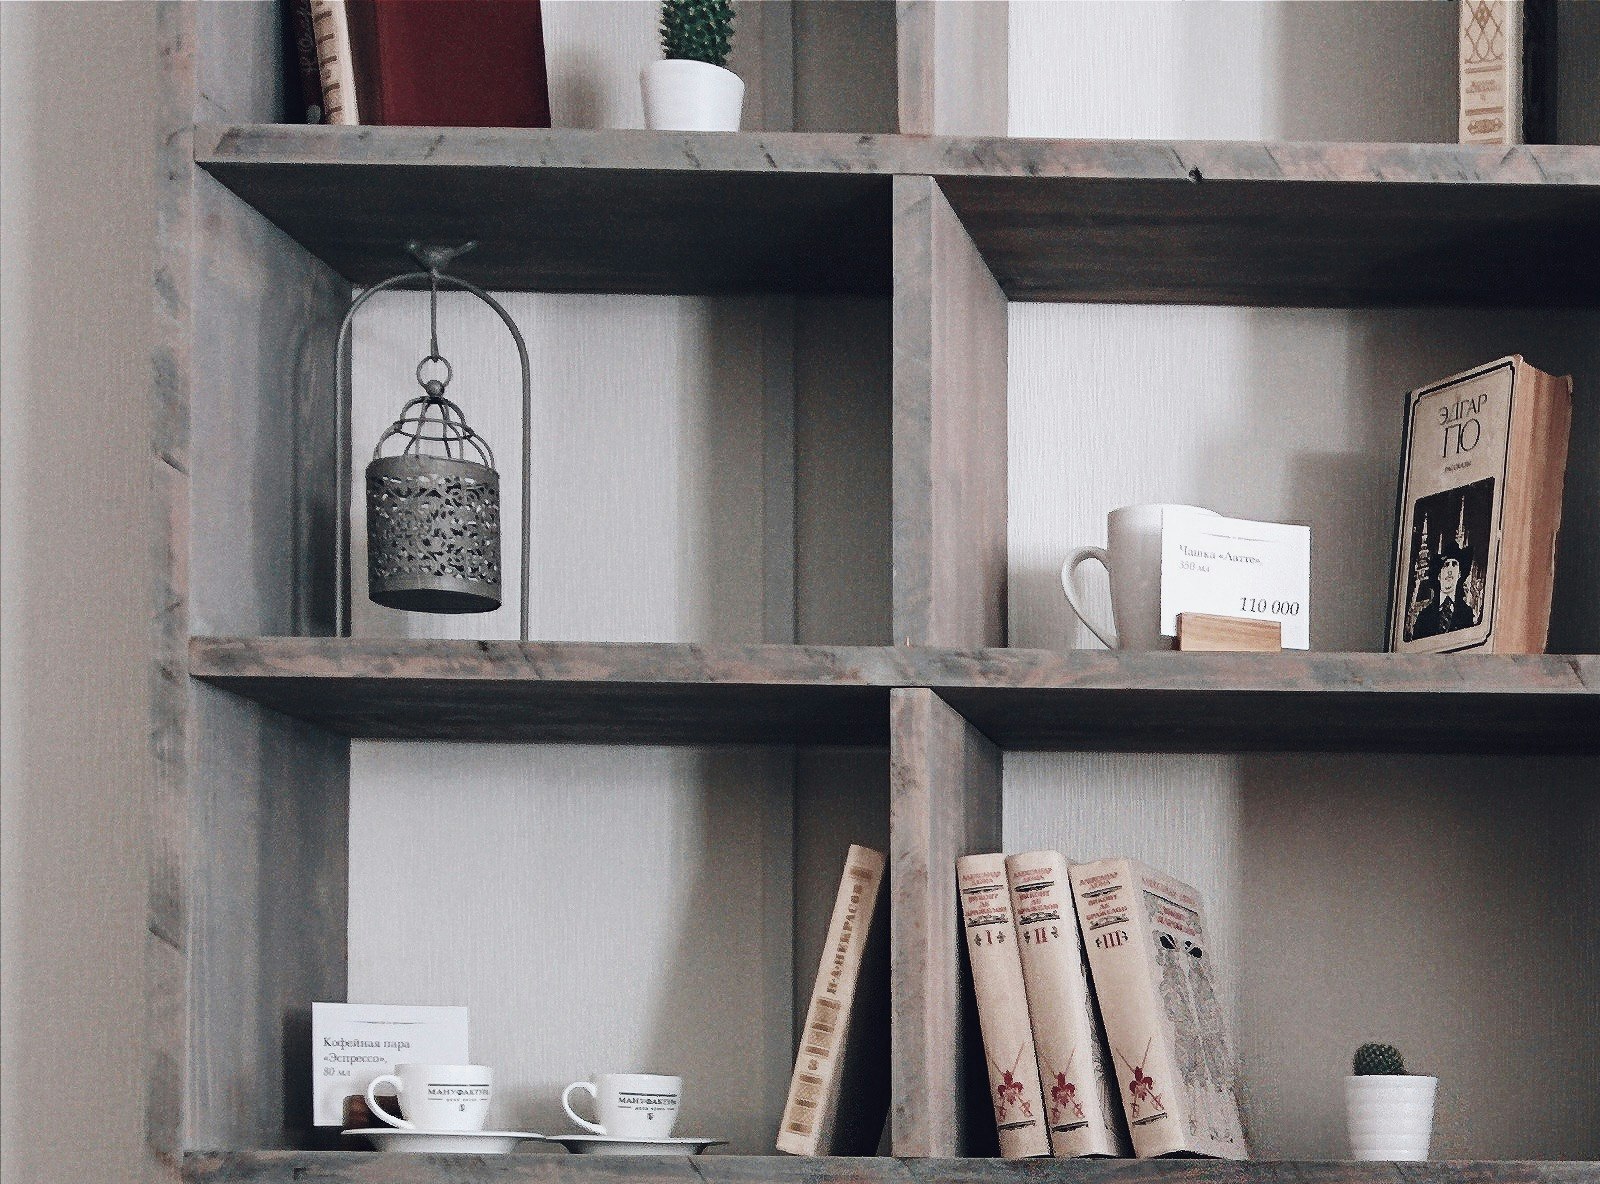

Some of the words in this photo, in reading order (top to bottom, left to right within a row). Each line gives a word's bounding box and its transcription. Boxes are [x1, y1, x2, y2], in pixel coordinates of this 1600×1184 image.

[1440, 393, 1488, 425] ЭДГАР
[1442, 418, 1480, 458] ПО
[1180, 545, 1216, 560] Чашка
[1240, 597, 1268, 613] 110
[1271, 599, 1300, 616] 000
[323, 1037, 380, 1050] Кофейная
[383, 1041, 411, 1051] пара
